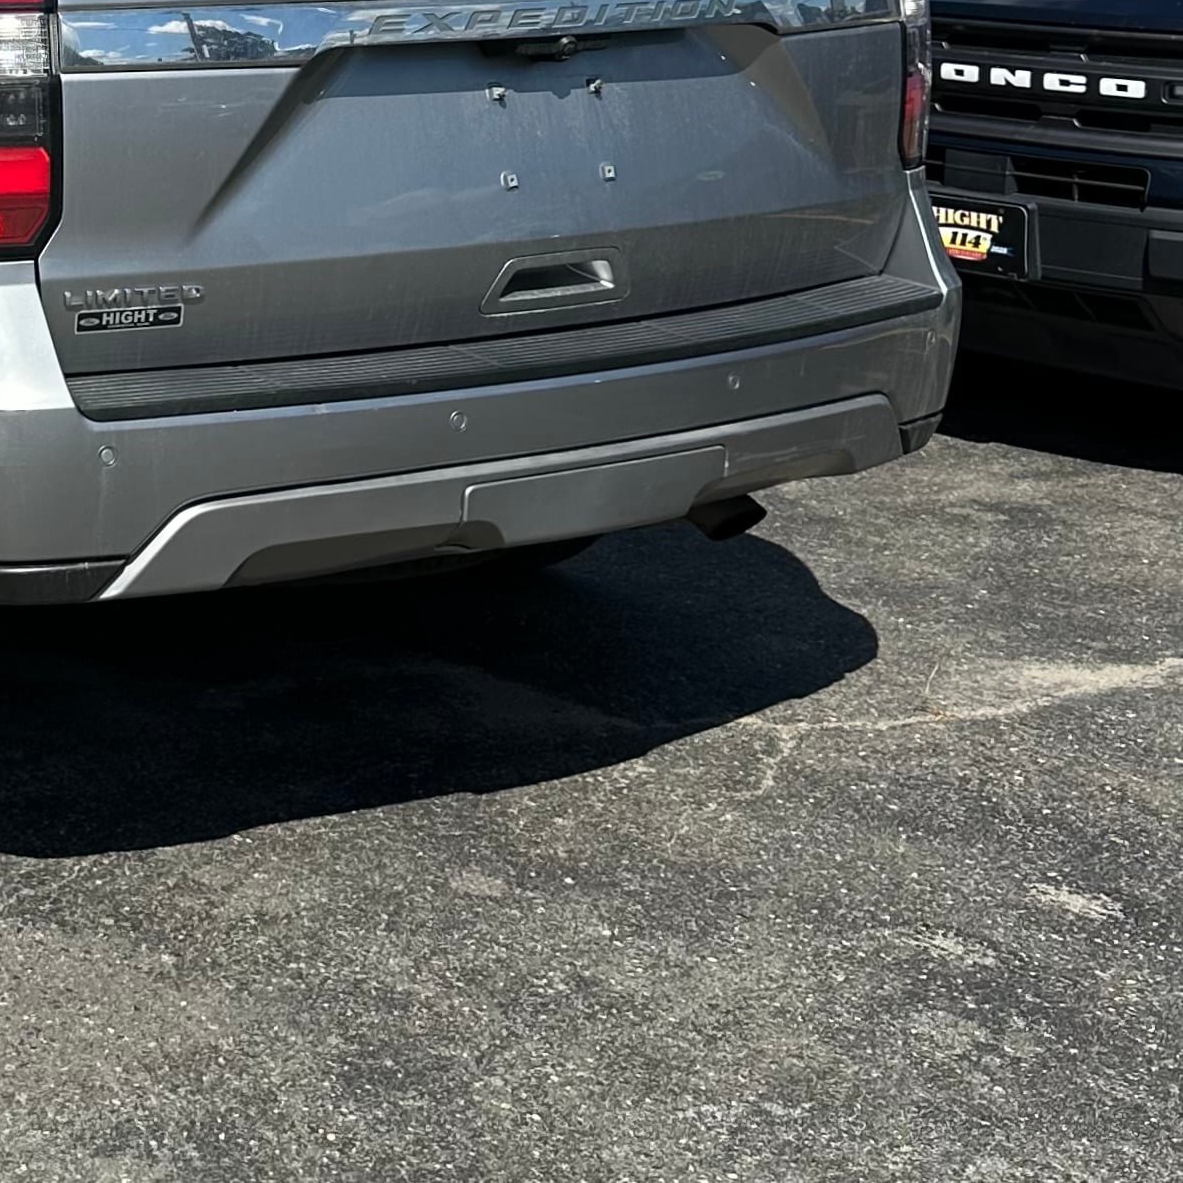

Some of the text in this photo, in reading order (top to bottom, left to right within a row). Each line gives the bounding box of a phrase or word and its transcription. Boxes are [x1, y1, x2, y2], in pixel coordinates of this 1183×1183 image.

[940, 62, 1147, 99] ONCO
[932, 205, 1003, 234] HIGHT
[64, 284, 204, 311] LIMITED
[101, 309, 158, 326] HIGHT
